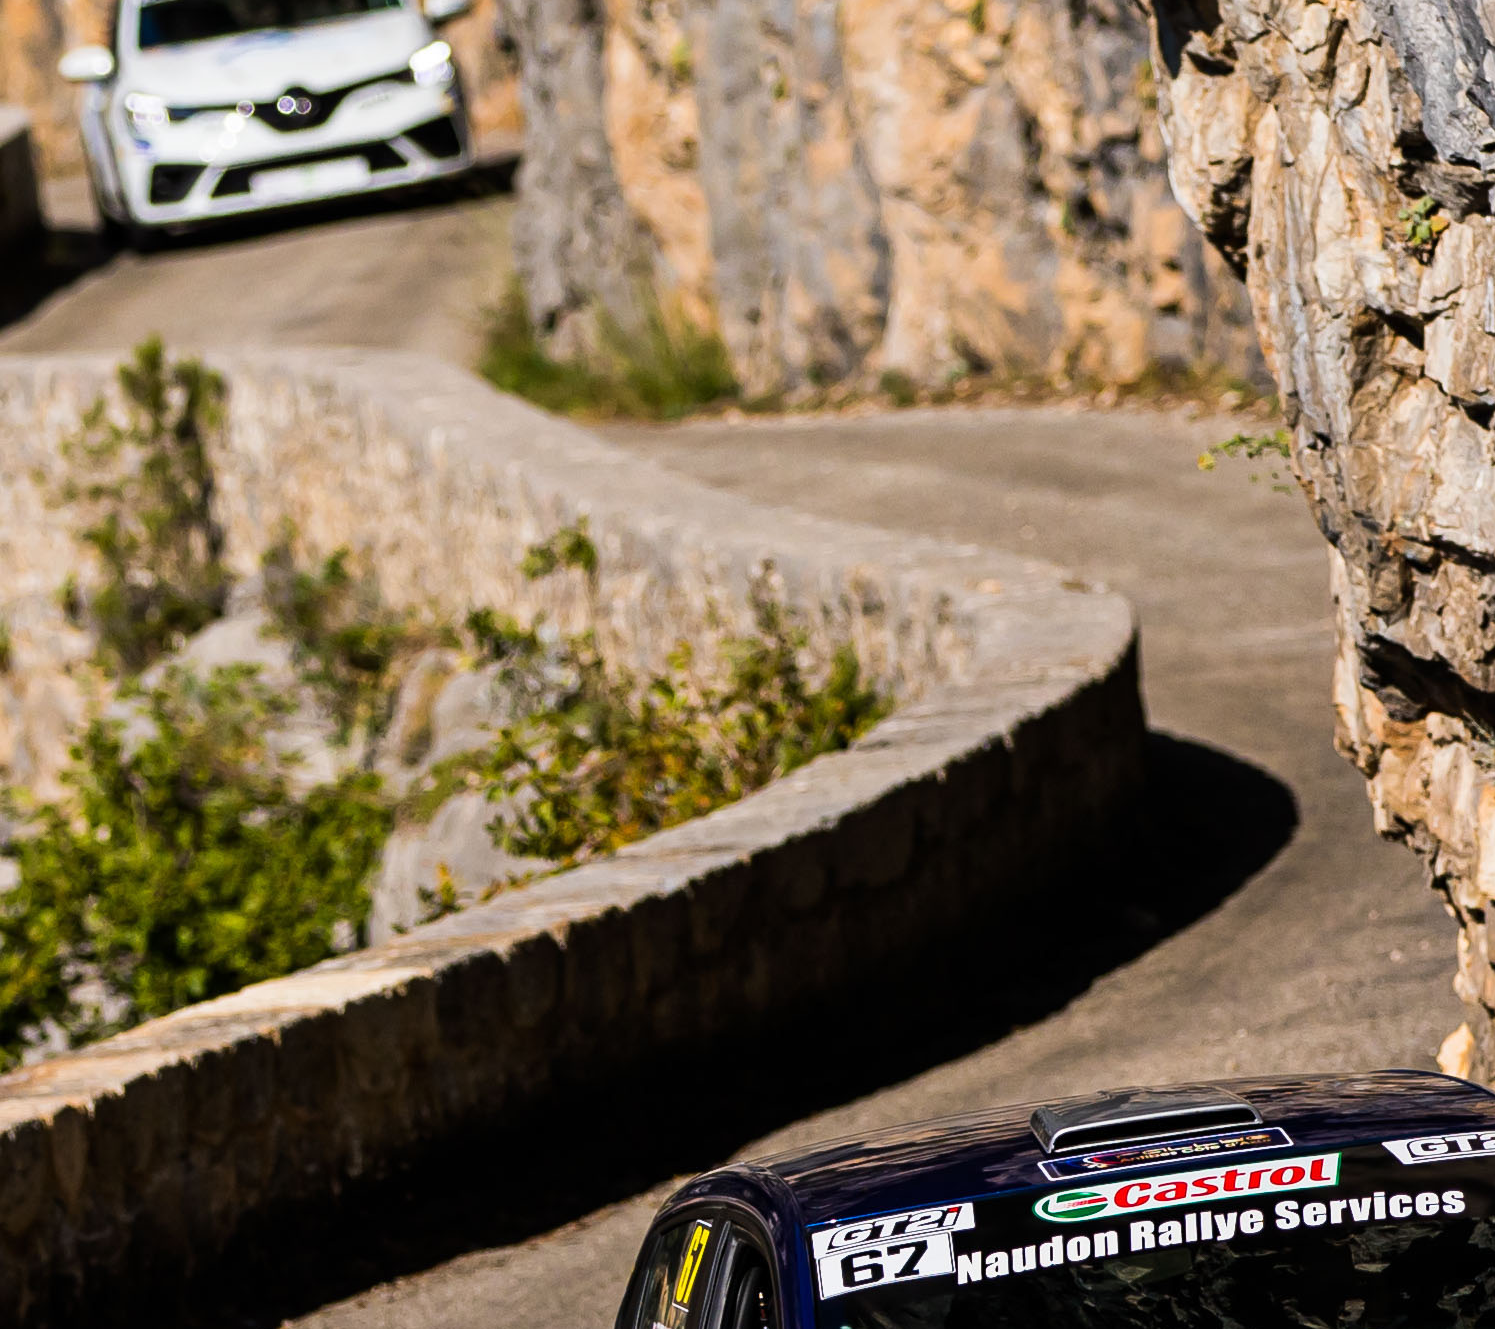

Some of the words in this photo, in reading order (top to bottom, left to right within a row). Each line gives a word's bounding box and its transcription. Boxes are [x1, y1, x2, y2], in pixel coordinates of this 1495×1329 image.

[1113, 1158, 1331, 1208] Castrol
[828, 1206, 961, 1251] GT2i
[957, 1229, 1118, 1286] Naudon
[1129, 1208, 1264, 1252] Rallye
[1274, 1190, 1466, 1231] Services
[675, 1225, 710, 1304] 67
[840, 1239, 929, 1288] 67
